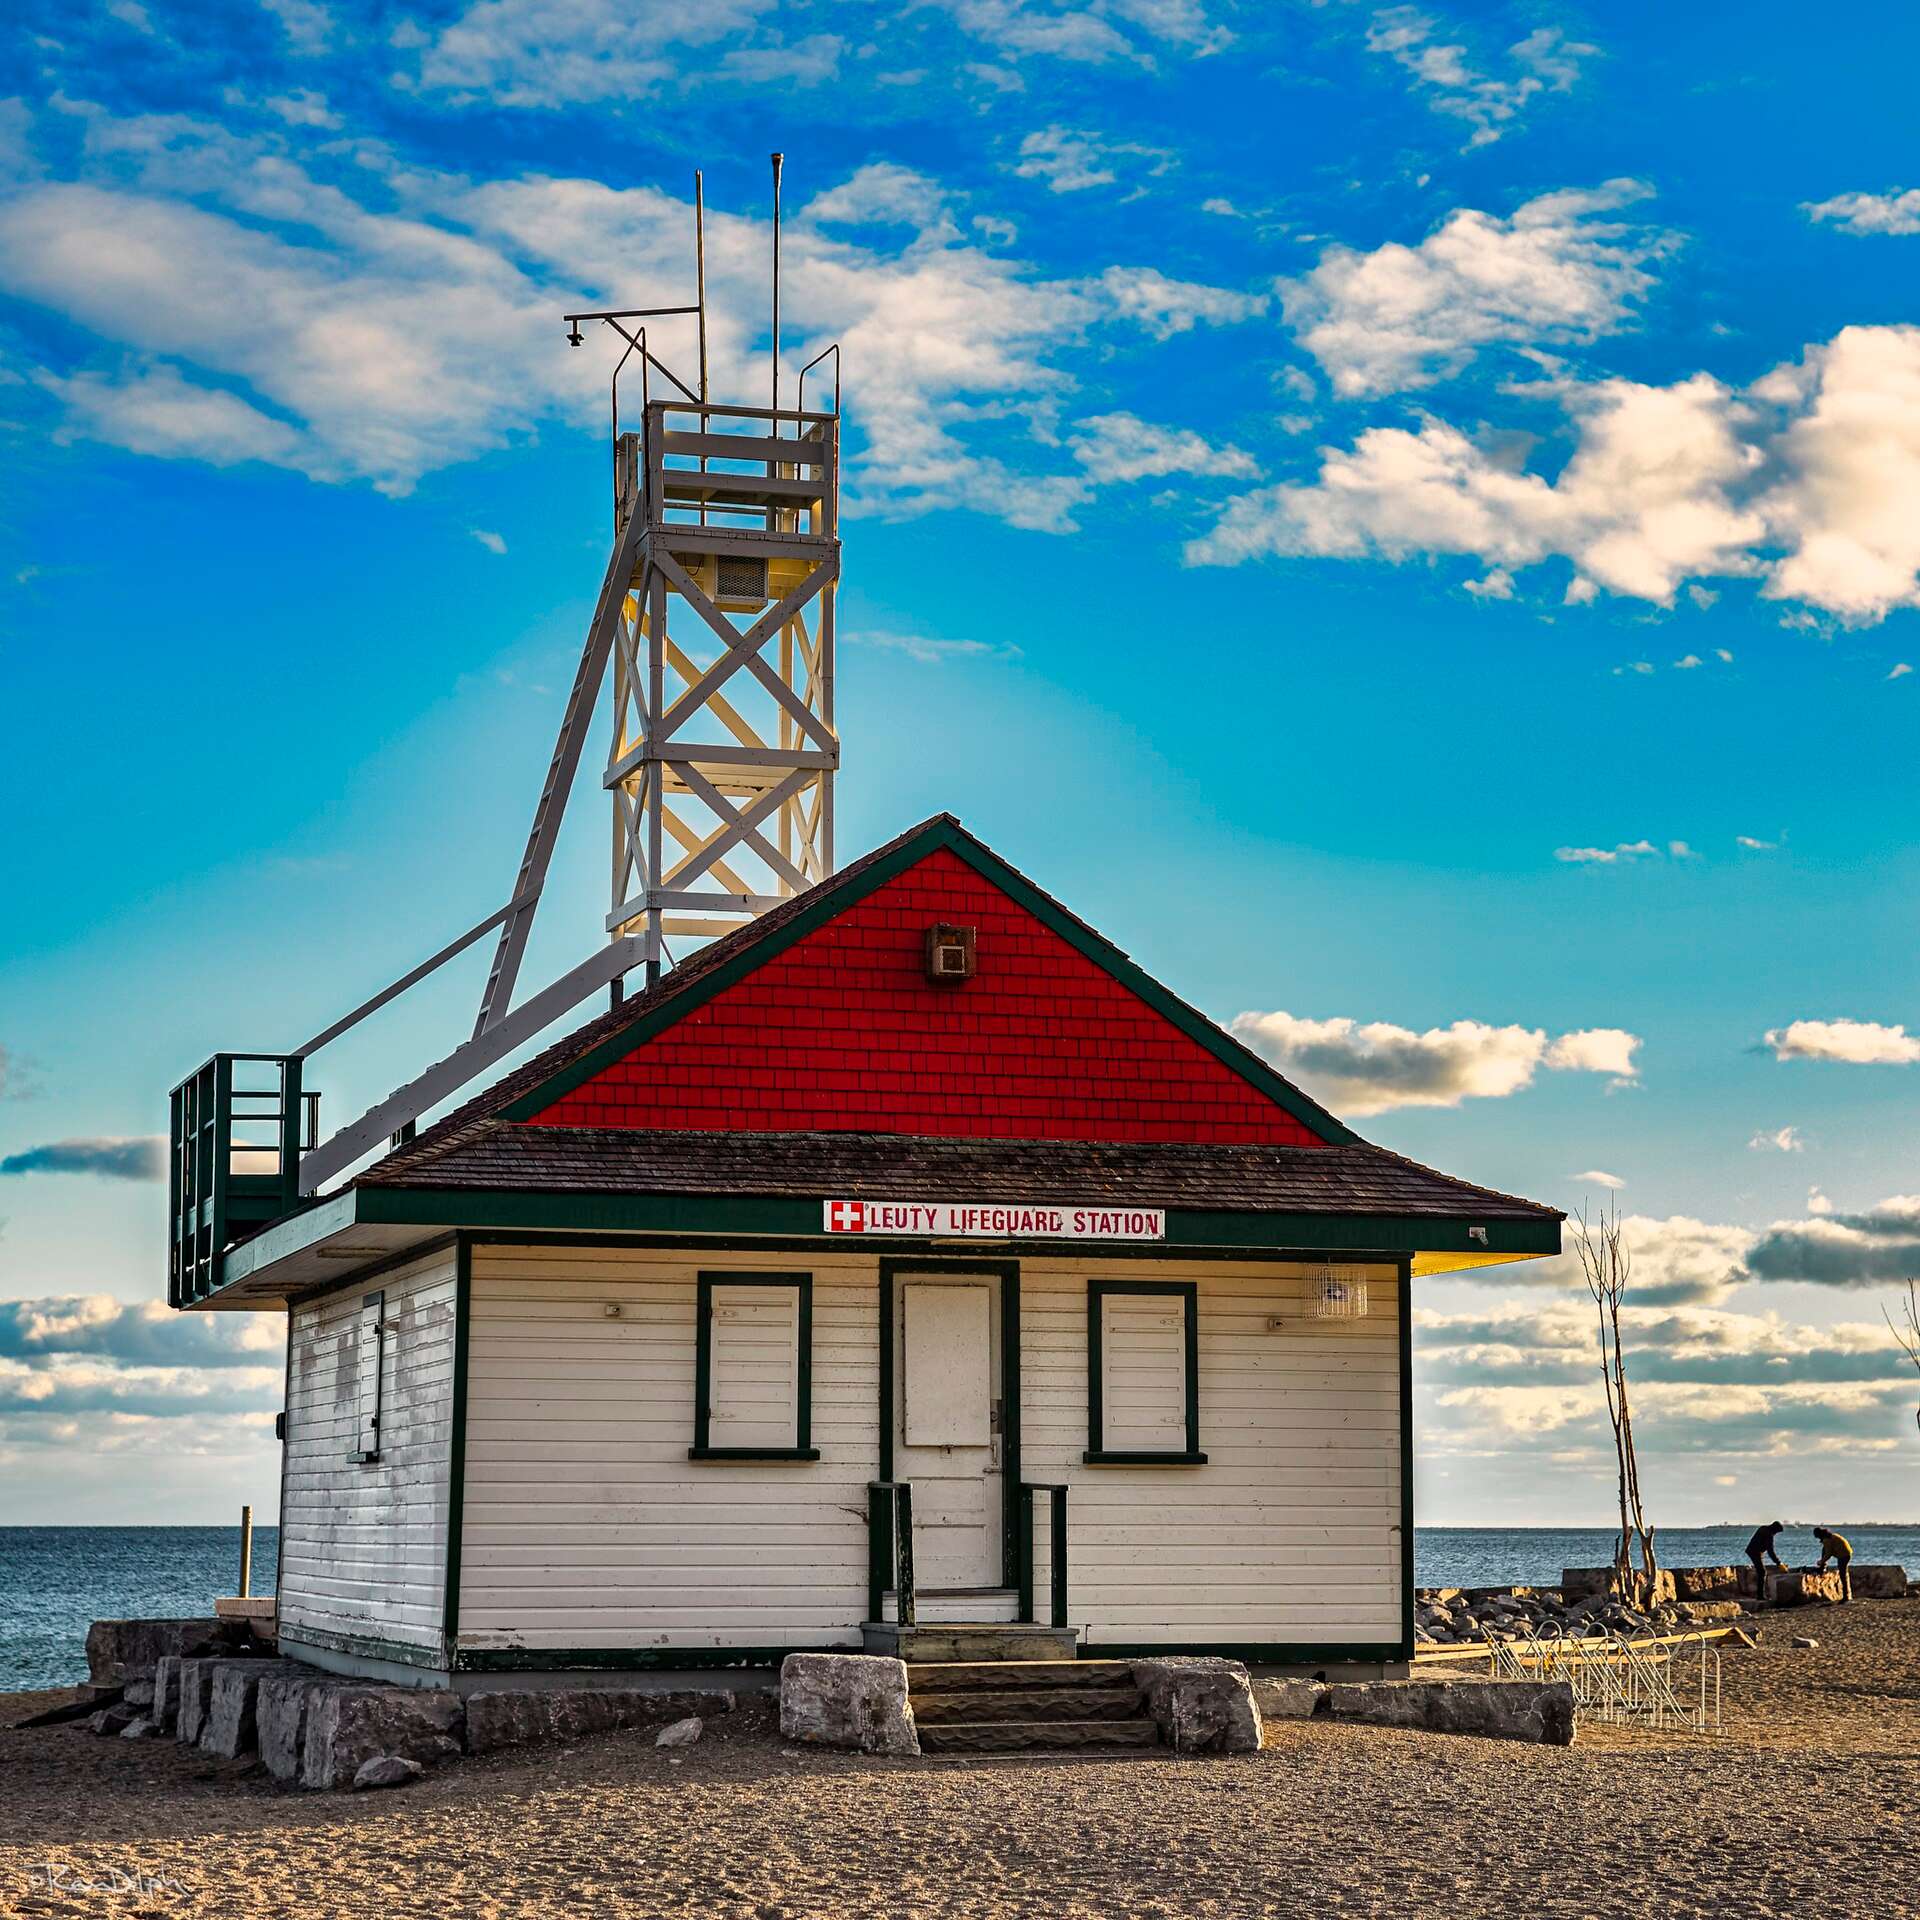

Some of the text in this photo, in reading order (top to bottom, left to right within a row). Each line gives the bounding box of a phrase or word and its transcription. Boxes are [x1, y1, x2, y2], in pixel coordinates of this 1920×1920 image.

[870, 1207, 1159, 1234] LEUTY LIFEGUARD STATION
